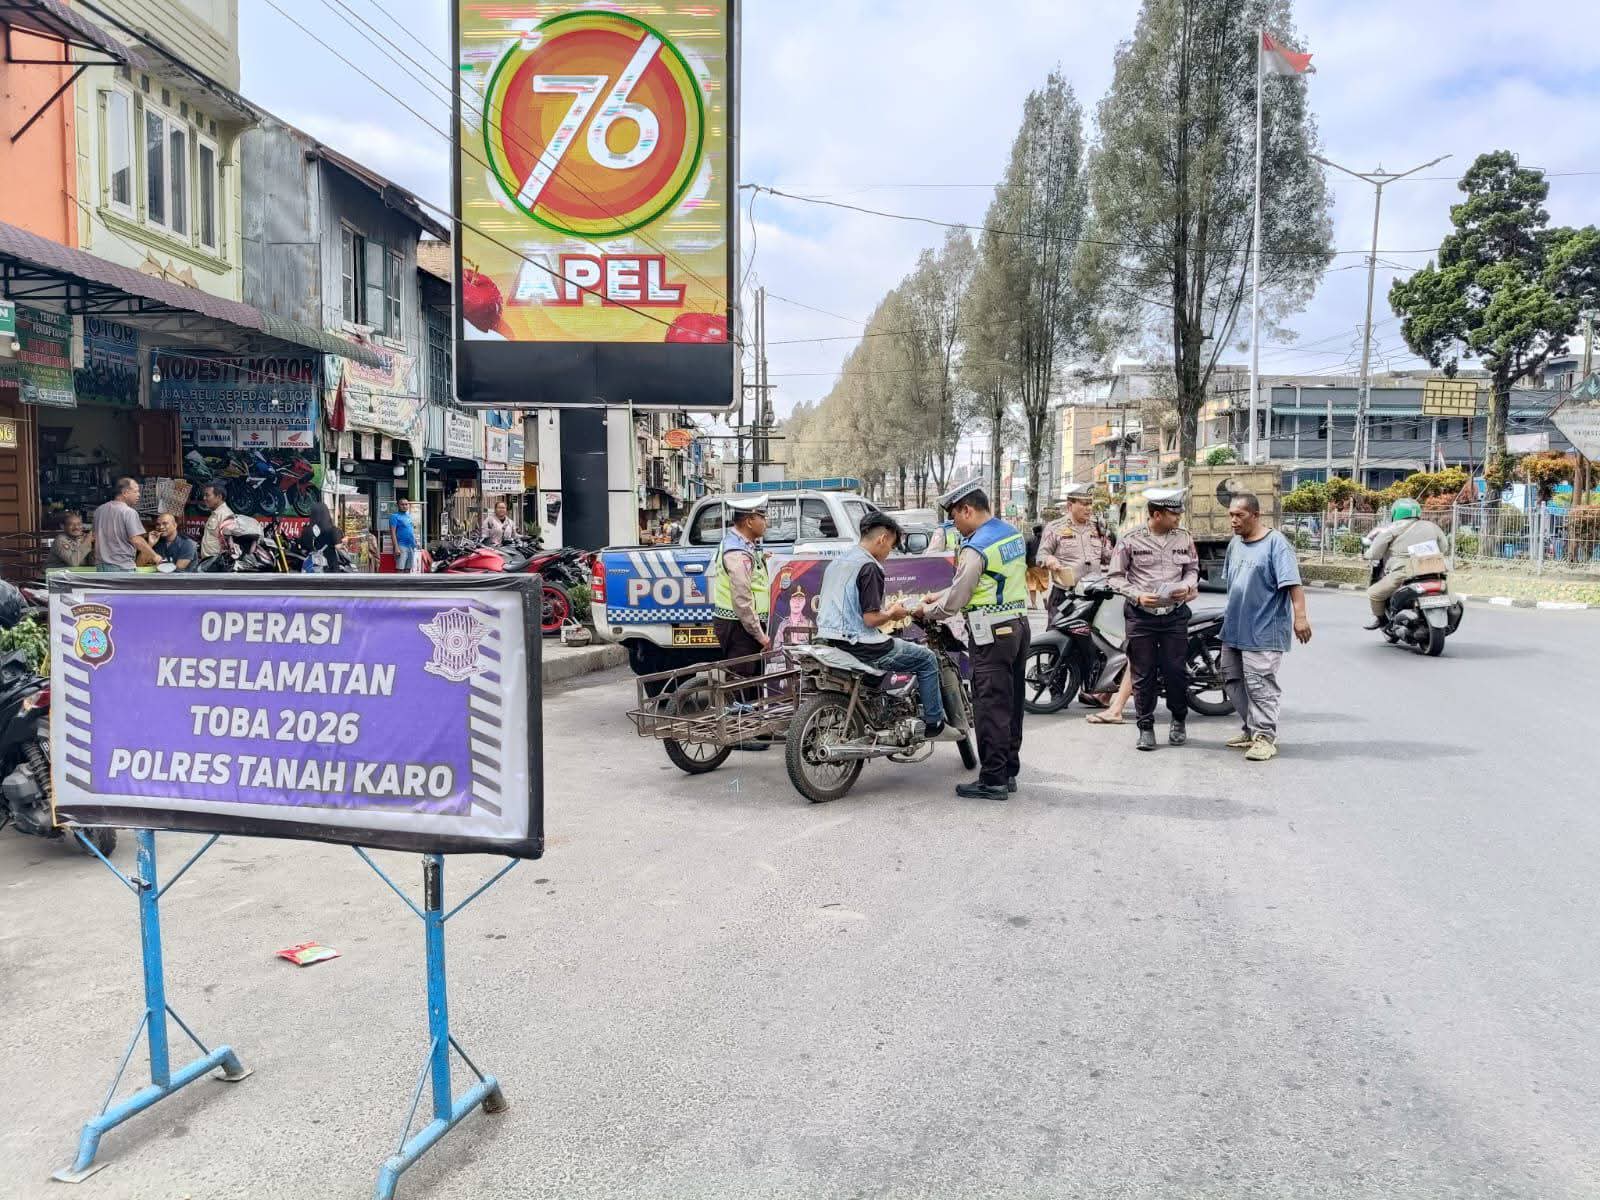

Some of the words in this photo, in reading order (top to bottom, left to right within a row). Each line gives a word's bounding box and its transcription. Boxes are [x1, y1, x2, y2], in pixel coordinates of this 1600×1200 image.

[516, 31, 662, 211] 76
[509, 253, 686, 306] APEL
[88, 318, 134, 343] OTOR
[159, 357, 243, 382] MODESTY
[247, 358, 314, 384] MOTOR
[207, 402, 244, 414] CASH
[247, 403, 256, 414] &
[258, 402, 306, 414] CREDIT
[218, 390, 266, 402] SEPEDA
[268, 390, 312, 402] MOTOR
[184, 416, 227, 425] VETERAN
[258, 417, 311, 426] BERASTAGI
[205, 434, 231, 442] YAMAHA
[627, 577, 715, 606] POLI
[201, 612, 343, 645] OPERASI
[156, 657, 395, 696] KESELAMATAN
[191, 706, 270, 740] TOBA
[275, 709, 360, 744] 2026
[108, 749, 231, 784] POLRES
[237, 755, 346, 792] TANAH
[353, 764, 453, 798] KARO
